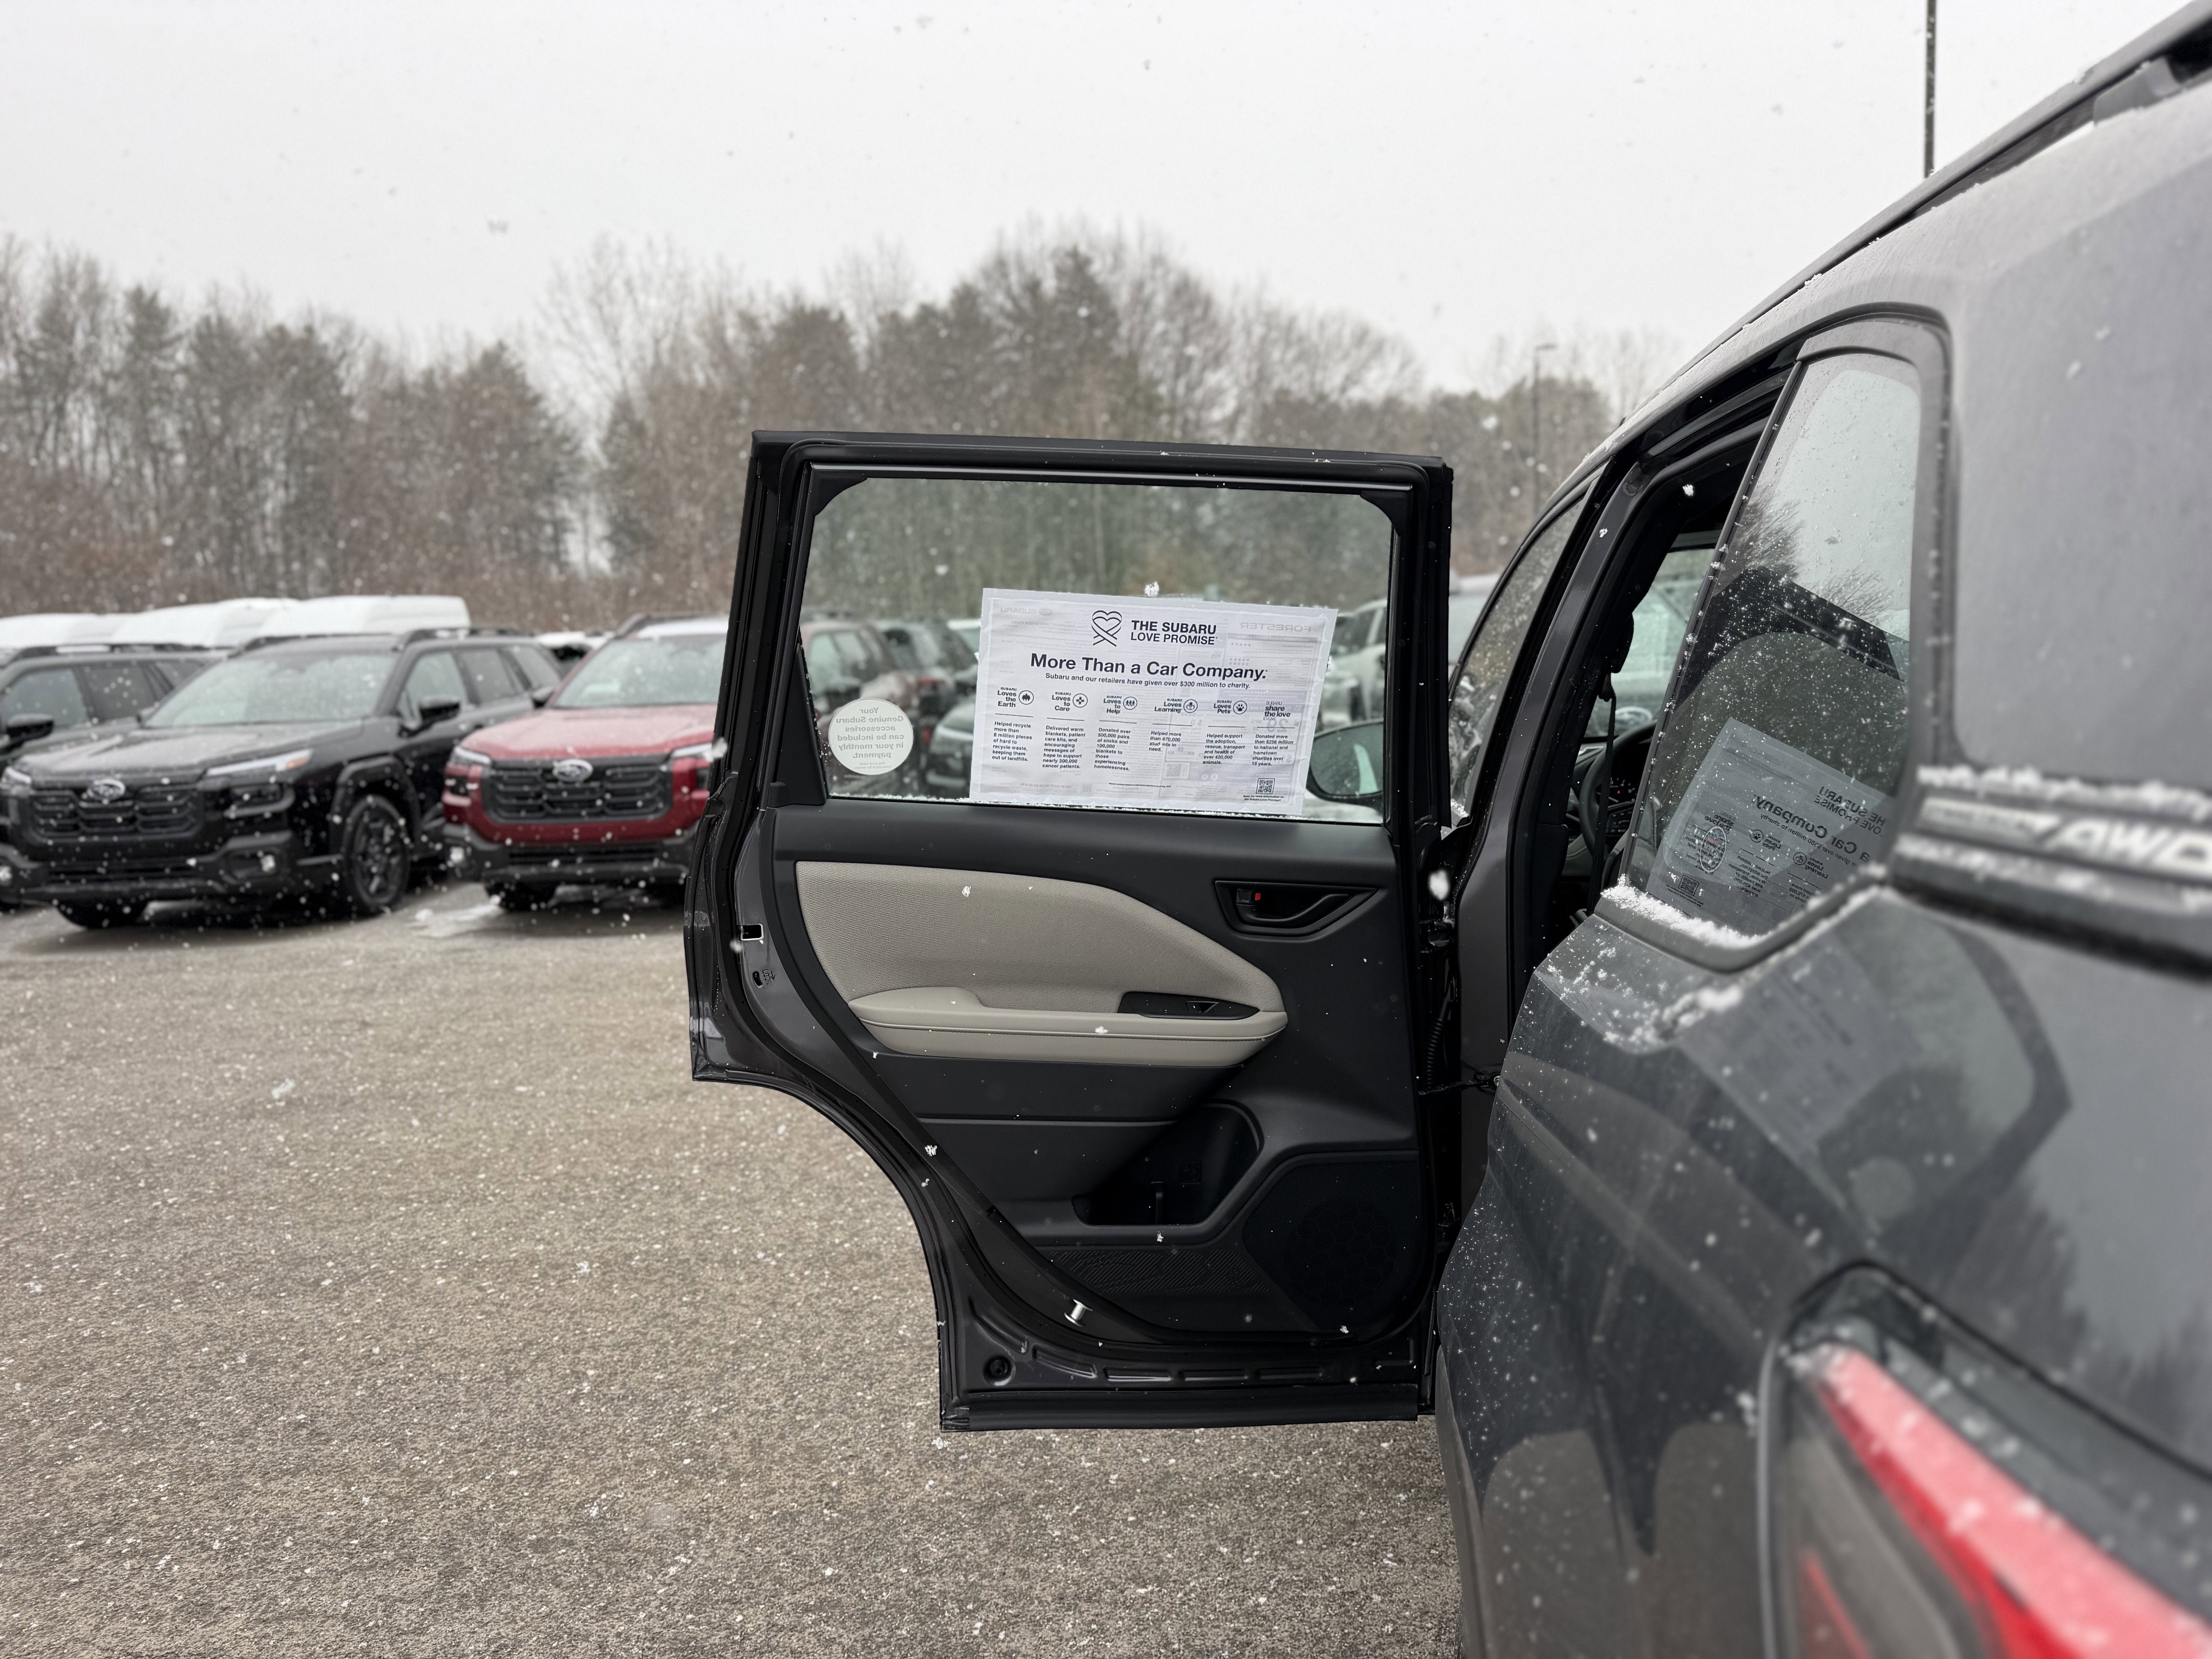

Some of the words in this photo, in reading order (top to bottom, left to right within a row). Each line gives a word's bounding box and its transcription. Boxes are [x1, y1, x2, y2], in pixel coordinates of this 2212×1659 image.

[1131, 620, 1158, 631] THE
[1162, 622, 1216, 634] SUBARU
[1131, 632, 1160, 642] LOVE
[1164, 634, 1215, 645] PROMISE
[1031, 653, 1076, 669] More
[1082, 657, 1125, 673] Than
[1131, 664, 1140, 674] a
[1147, 661, 1178, 675] Car
